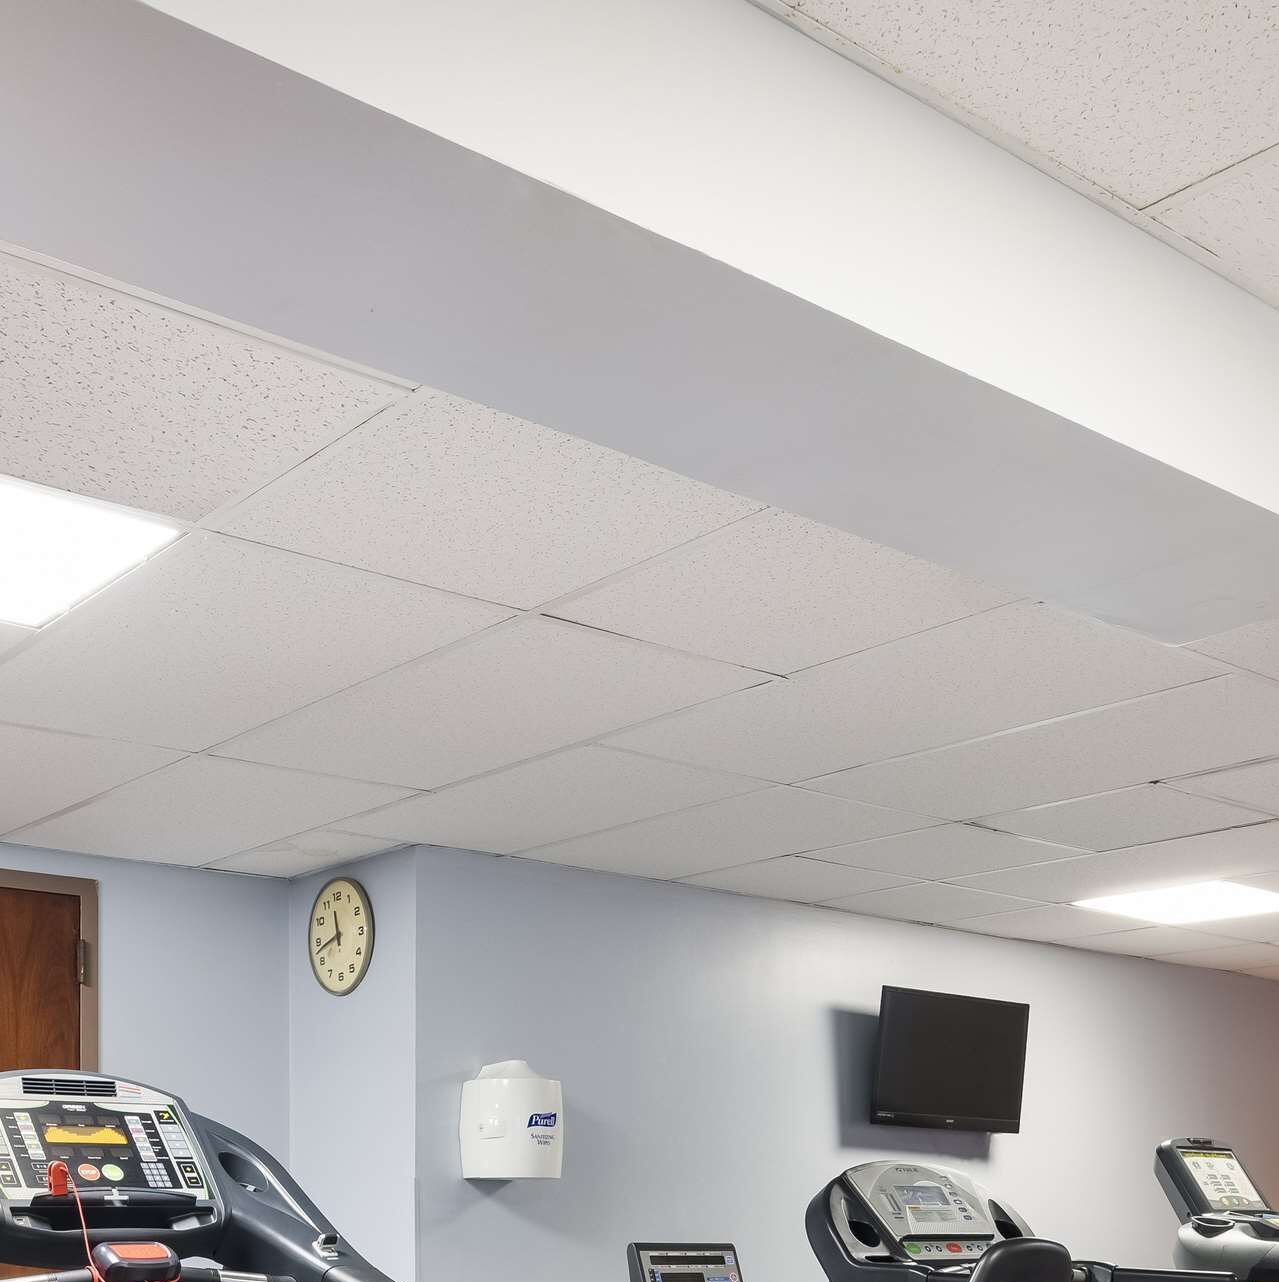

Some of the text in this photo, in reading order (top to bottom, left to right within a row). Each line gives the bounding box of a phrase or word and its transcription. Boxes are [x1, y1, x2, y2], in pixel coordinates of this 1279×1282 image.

[332, 892, 342, 902] 12
[346, 894, 351, 904] 1
[323, 901, 330, 911] 11
[354, 907, 360, 916] 2
[316, 917, 325, 926] 10
[358, 927, 364, 935] 3
[316, 938, 321, 947] 9
[356, 947, 361, 955] 4
[320, 957, 325, 966] 8
[349, 964, 355, 973] 5
[328, 969, 333, 978] 7
[338, 972, 344, 981] 6
